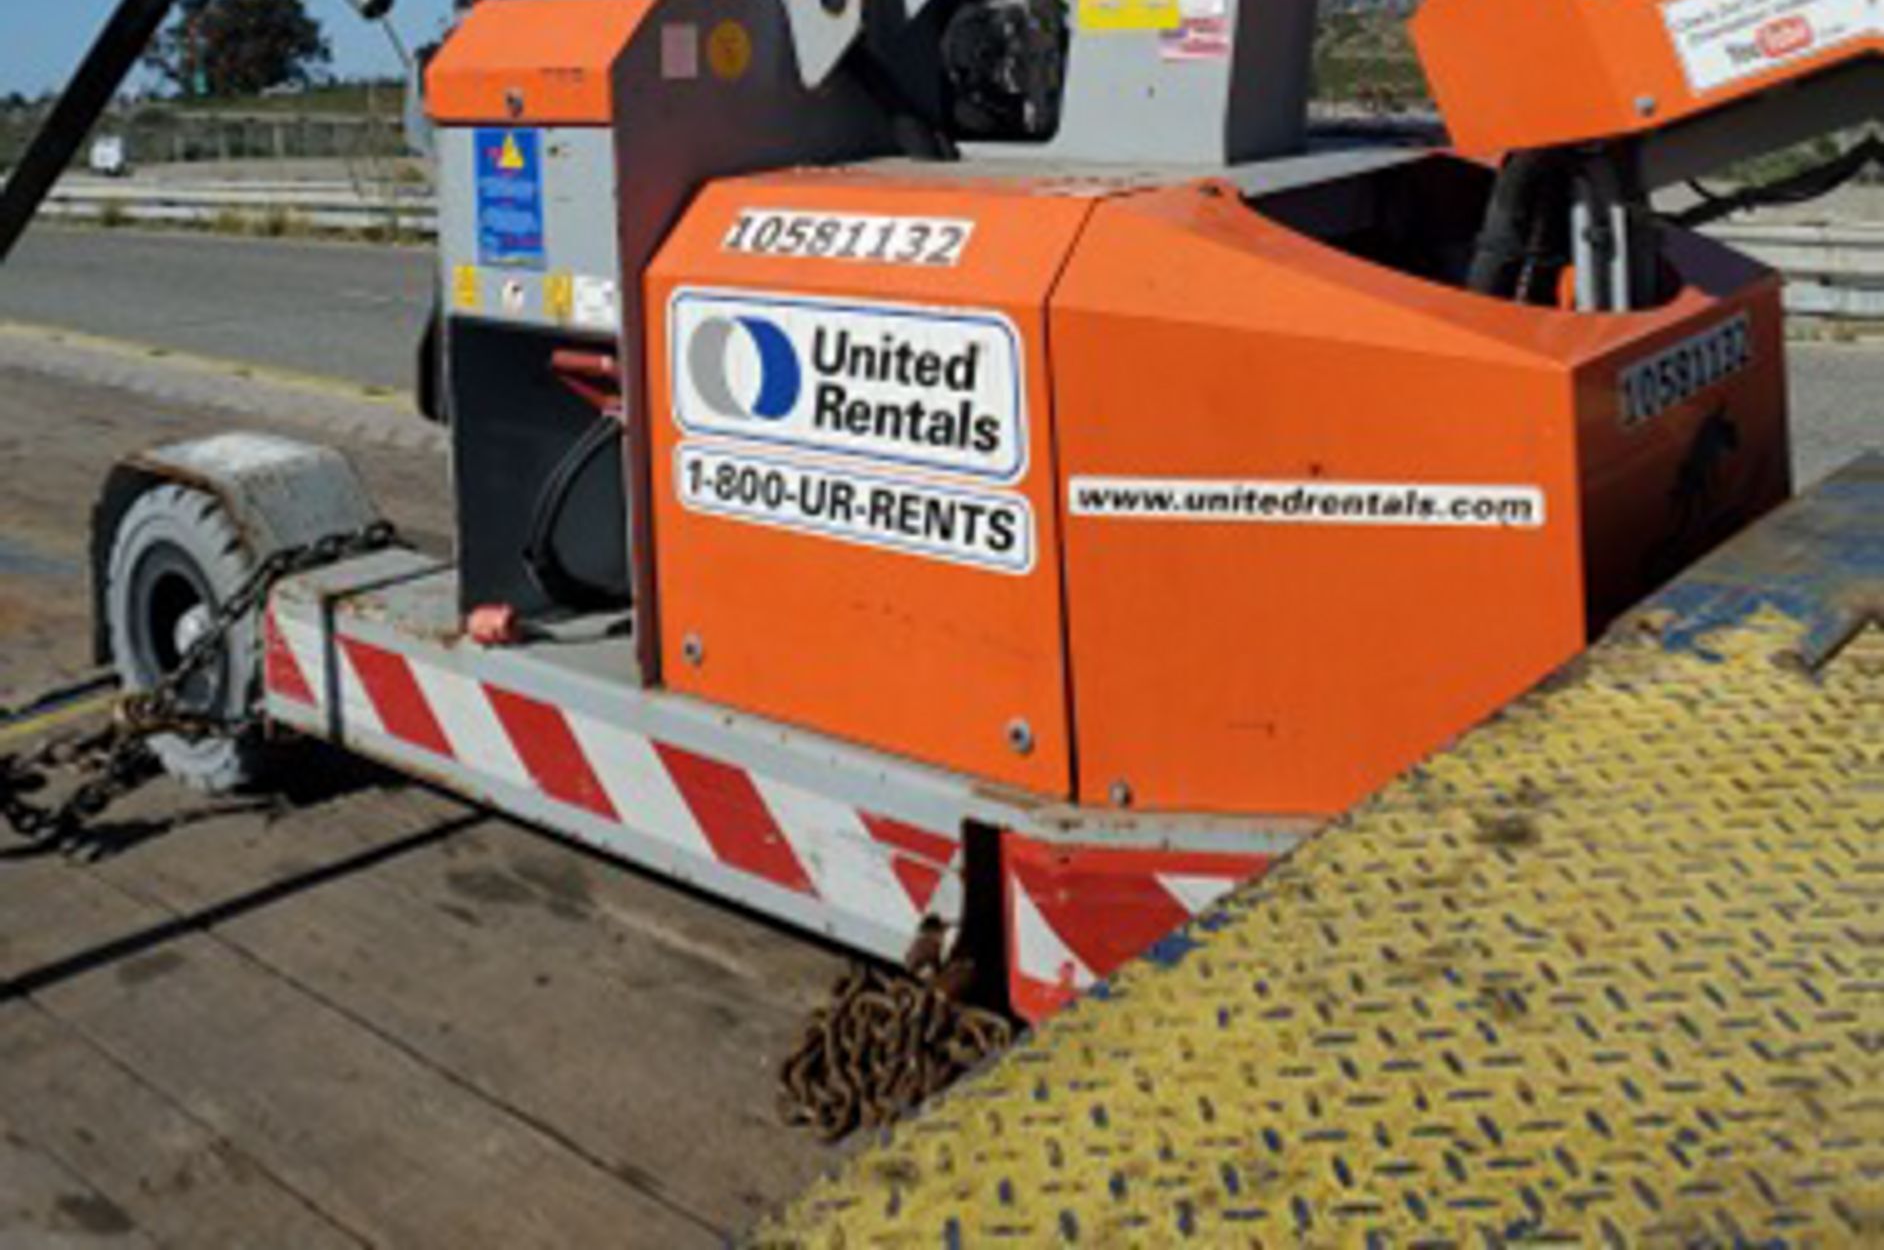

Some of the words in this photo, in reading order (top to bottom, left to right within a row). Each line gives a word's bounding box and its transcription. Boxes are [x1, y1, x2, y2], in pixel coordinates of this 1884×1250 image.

[724, 215, 968, 265] 10581132
[811, 326, 980, 391] United
[813, 383, 1001, 454] Rentals
[686, 458, 1017, 553] 1-800-UR-RENTS
[1077, 483, 1534, 521] www.unitedrentals.com
